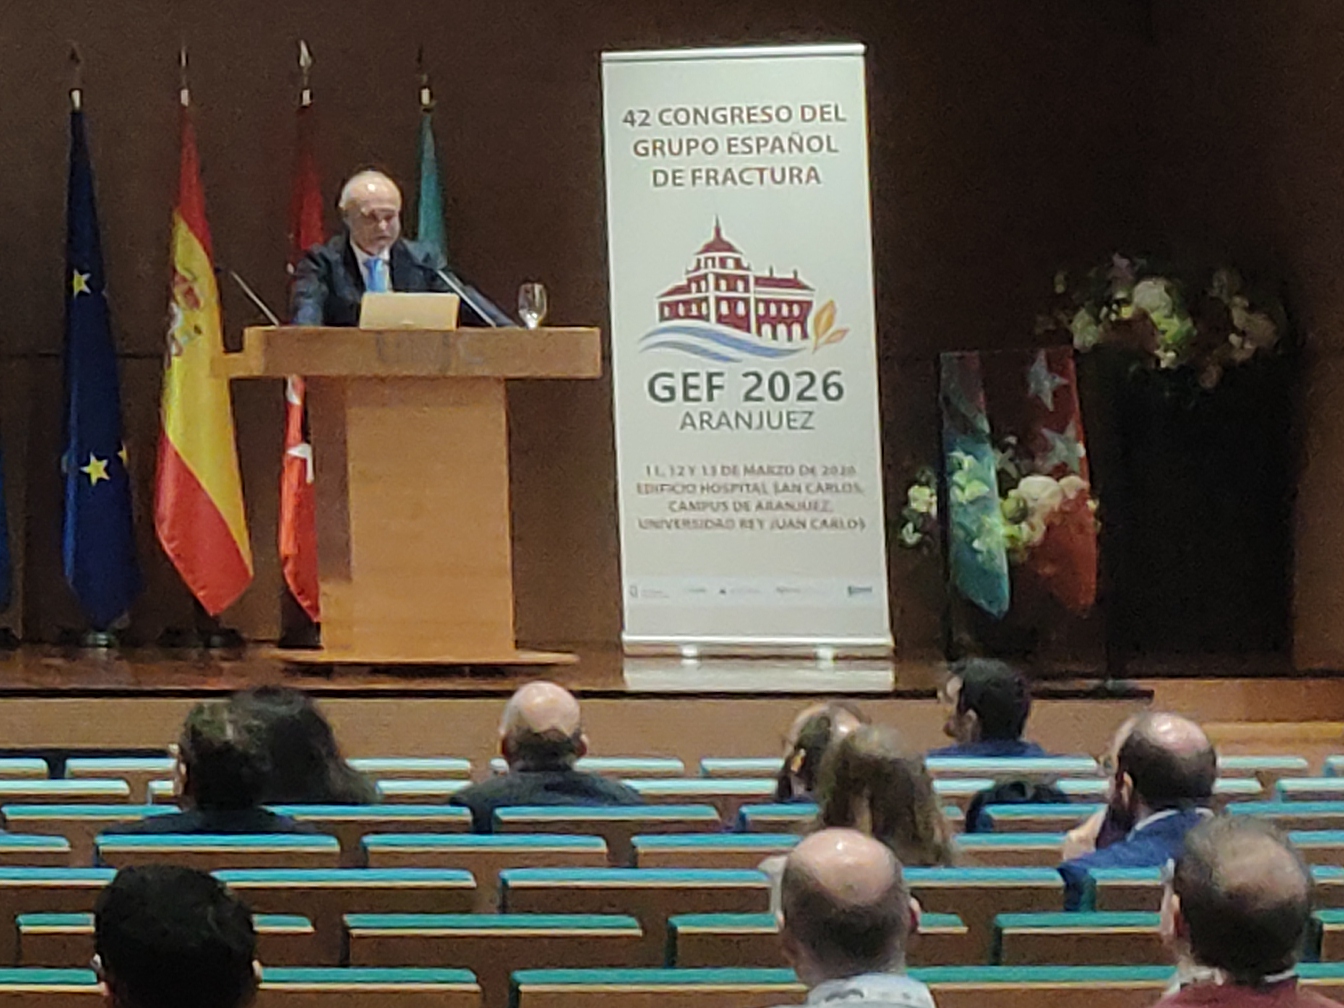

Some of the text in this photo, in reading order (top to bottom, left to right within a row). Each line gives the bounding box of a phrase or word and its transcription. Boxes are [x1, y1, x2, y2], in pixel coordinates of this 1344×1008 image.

[622, 104, 847, 127] 42 CONGRESO DEL
[633, 132, 839, 157] GRUPO ESPAÑOL
[652, 166, 822, 187] DE FRACTURA
[648, 370, 845, 403] GEF 2026
[679, 410, 815, 431] ARANJUEZ
[721, 465, 740, 476] DE
[743, 464, 795, 477] MARZO
[799, 465, 816, 476] DE
[700, 482, 769, 495] HOSPITAL
[668, 500, 729, 513] CAMPUS
[733, 500, 750, 512] DE
